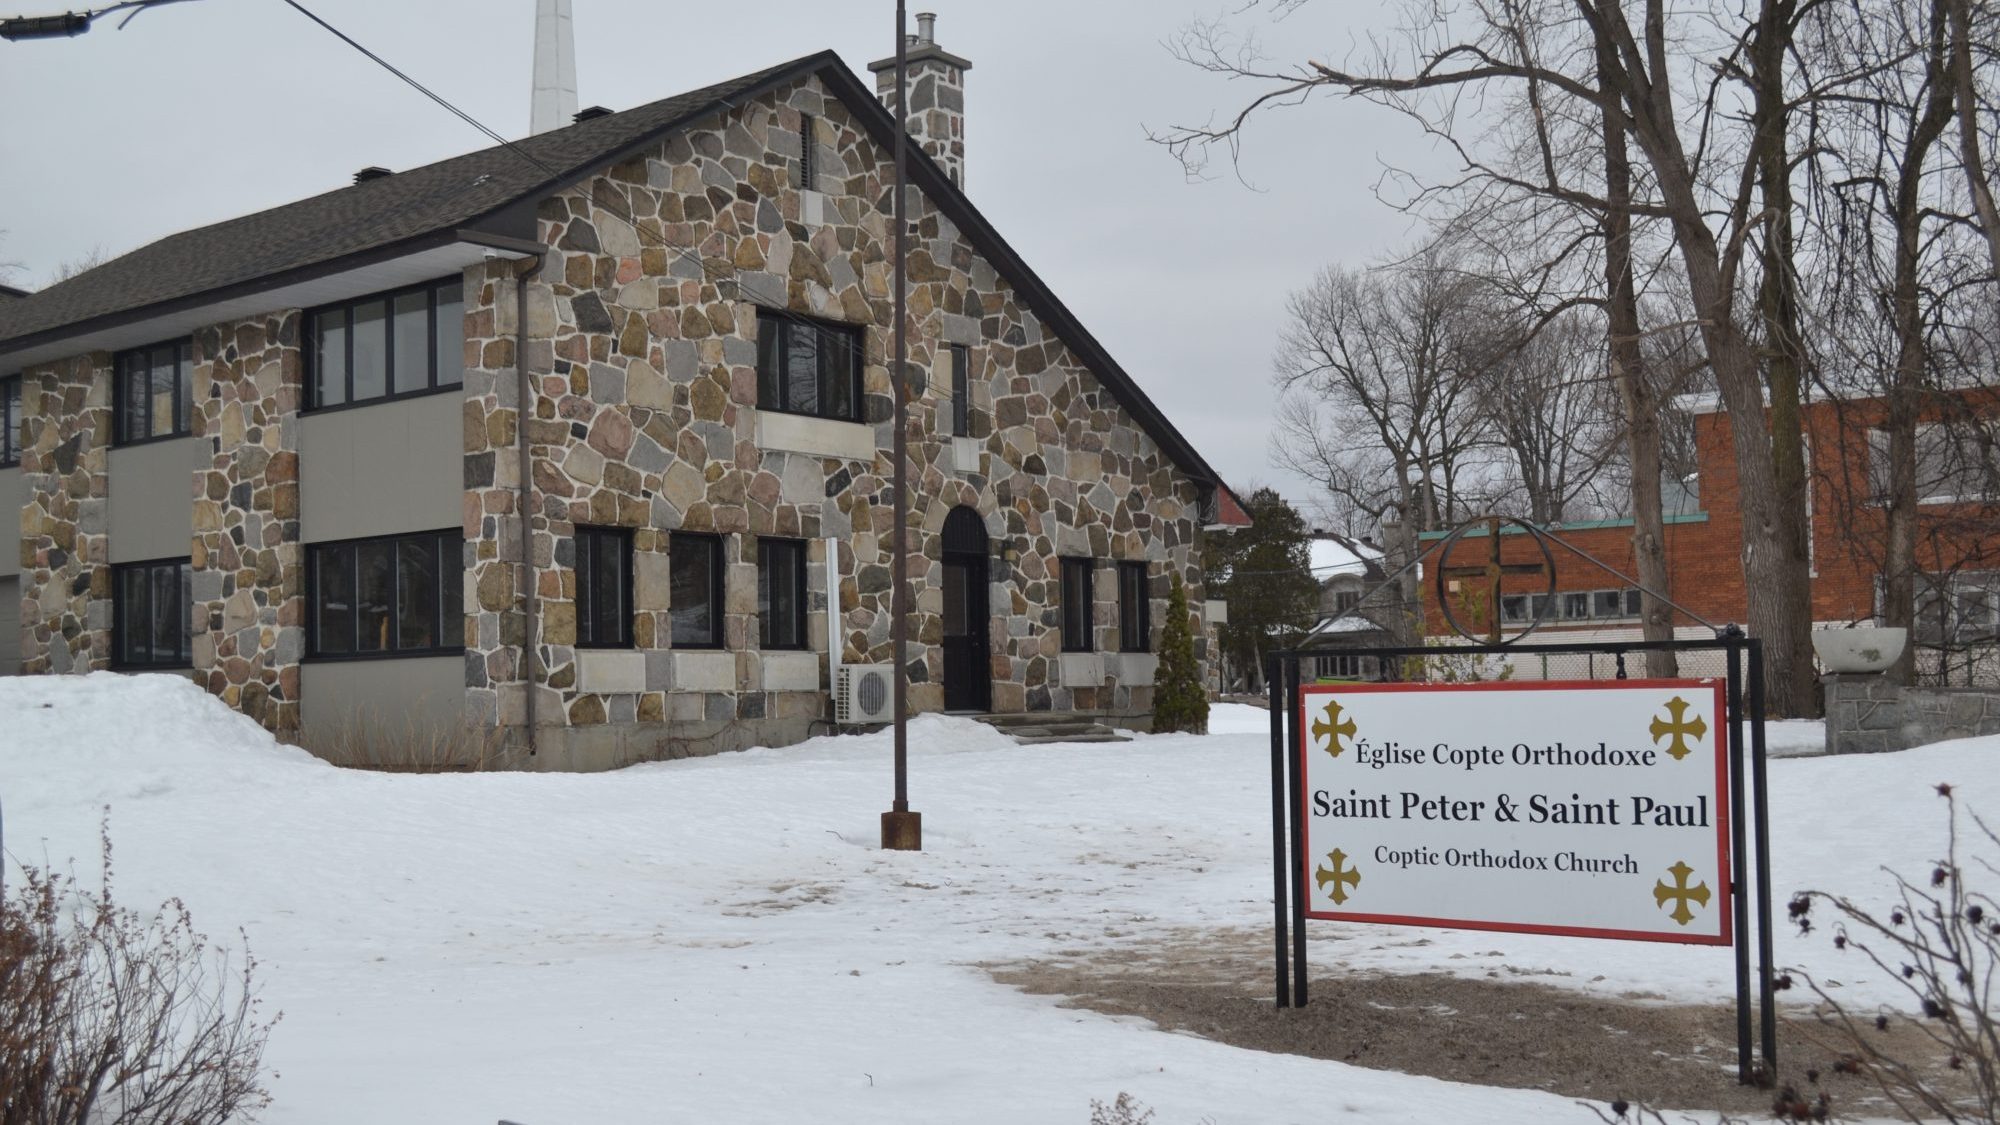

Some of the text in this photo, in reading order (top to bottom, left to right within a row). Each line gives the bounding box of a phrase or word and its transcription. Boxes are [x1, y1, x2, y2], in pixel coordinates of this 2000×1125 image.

[1355, 737, 1657, 771] Église Copte Orthodoxe
[1313, 788, 1710, 828] Saint Peter & Saint Paul
[1374, 845, 1640, 875] Coptic Orthodox Church
